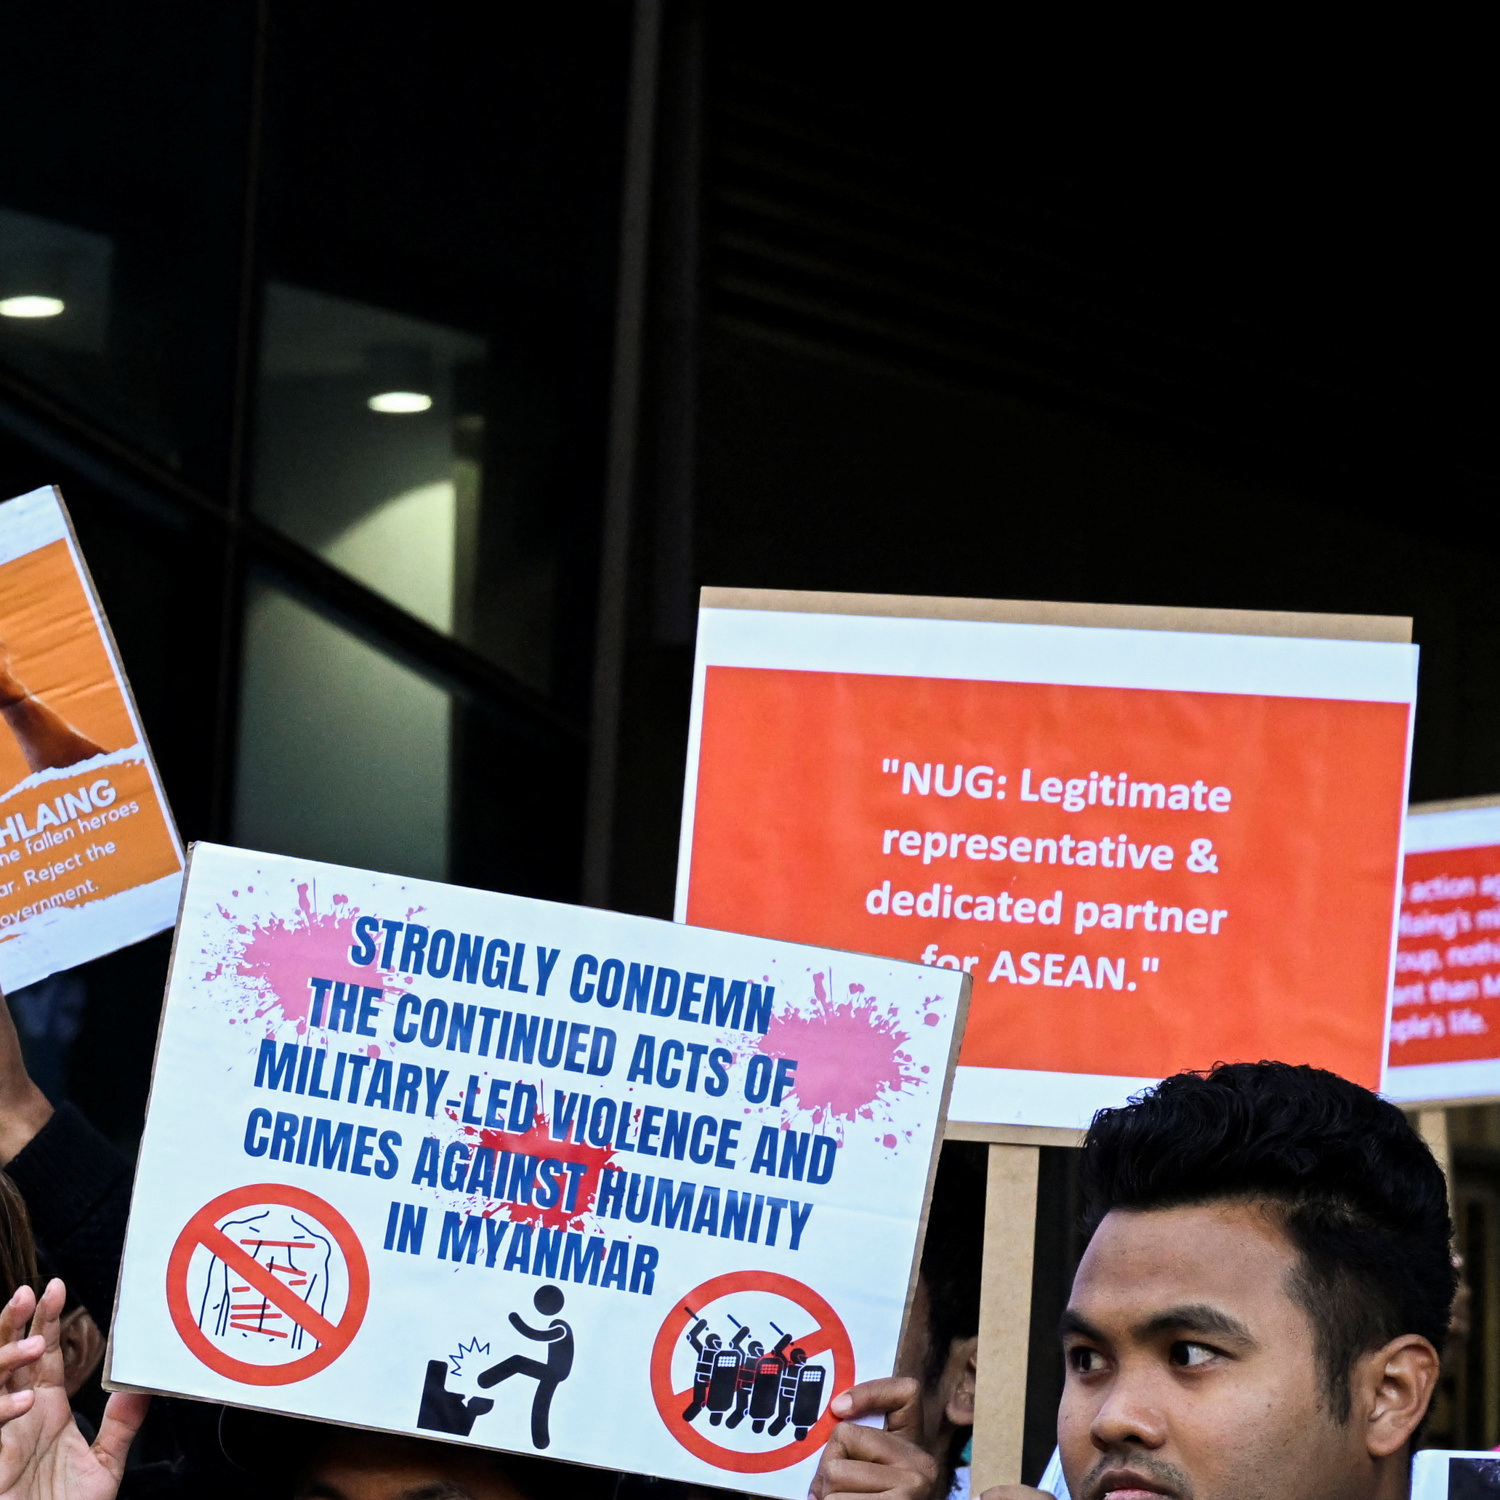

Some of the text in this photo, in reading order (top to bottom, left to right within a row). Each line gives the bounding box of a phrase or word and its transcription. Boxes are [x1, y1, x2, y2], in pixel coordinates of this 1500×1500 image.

[883, 758, 1231, 812] "NUG: Legitimate
[25, 826, 76, 856] fallen
[78, 800, 140, 835] heroes
[883, 830, 1218, 873] representative &
[23, 855, 84, 888] Reject
[86, 840, 117, 865] the
[866, 880, 1228, 935] dedicated partner
[352, 916, 775, 1034] STRONGLY CONDEMN
[988, 951, 1159, 991] ASEAN."
[310, 978, 797, 1107] THE CONTINUED ACTS OF
[254, 1040, 838, 1186] MILITARY-LED VIOLENCE AND
[244, 1108, 813, 1250] CRIMES AGAINST HUMANITY
[384, 1202, 659, 1295] IN MYANMAR
